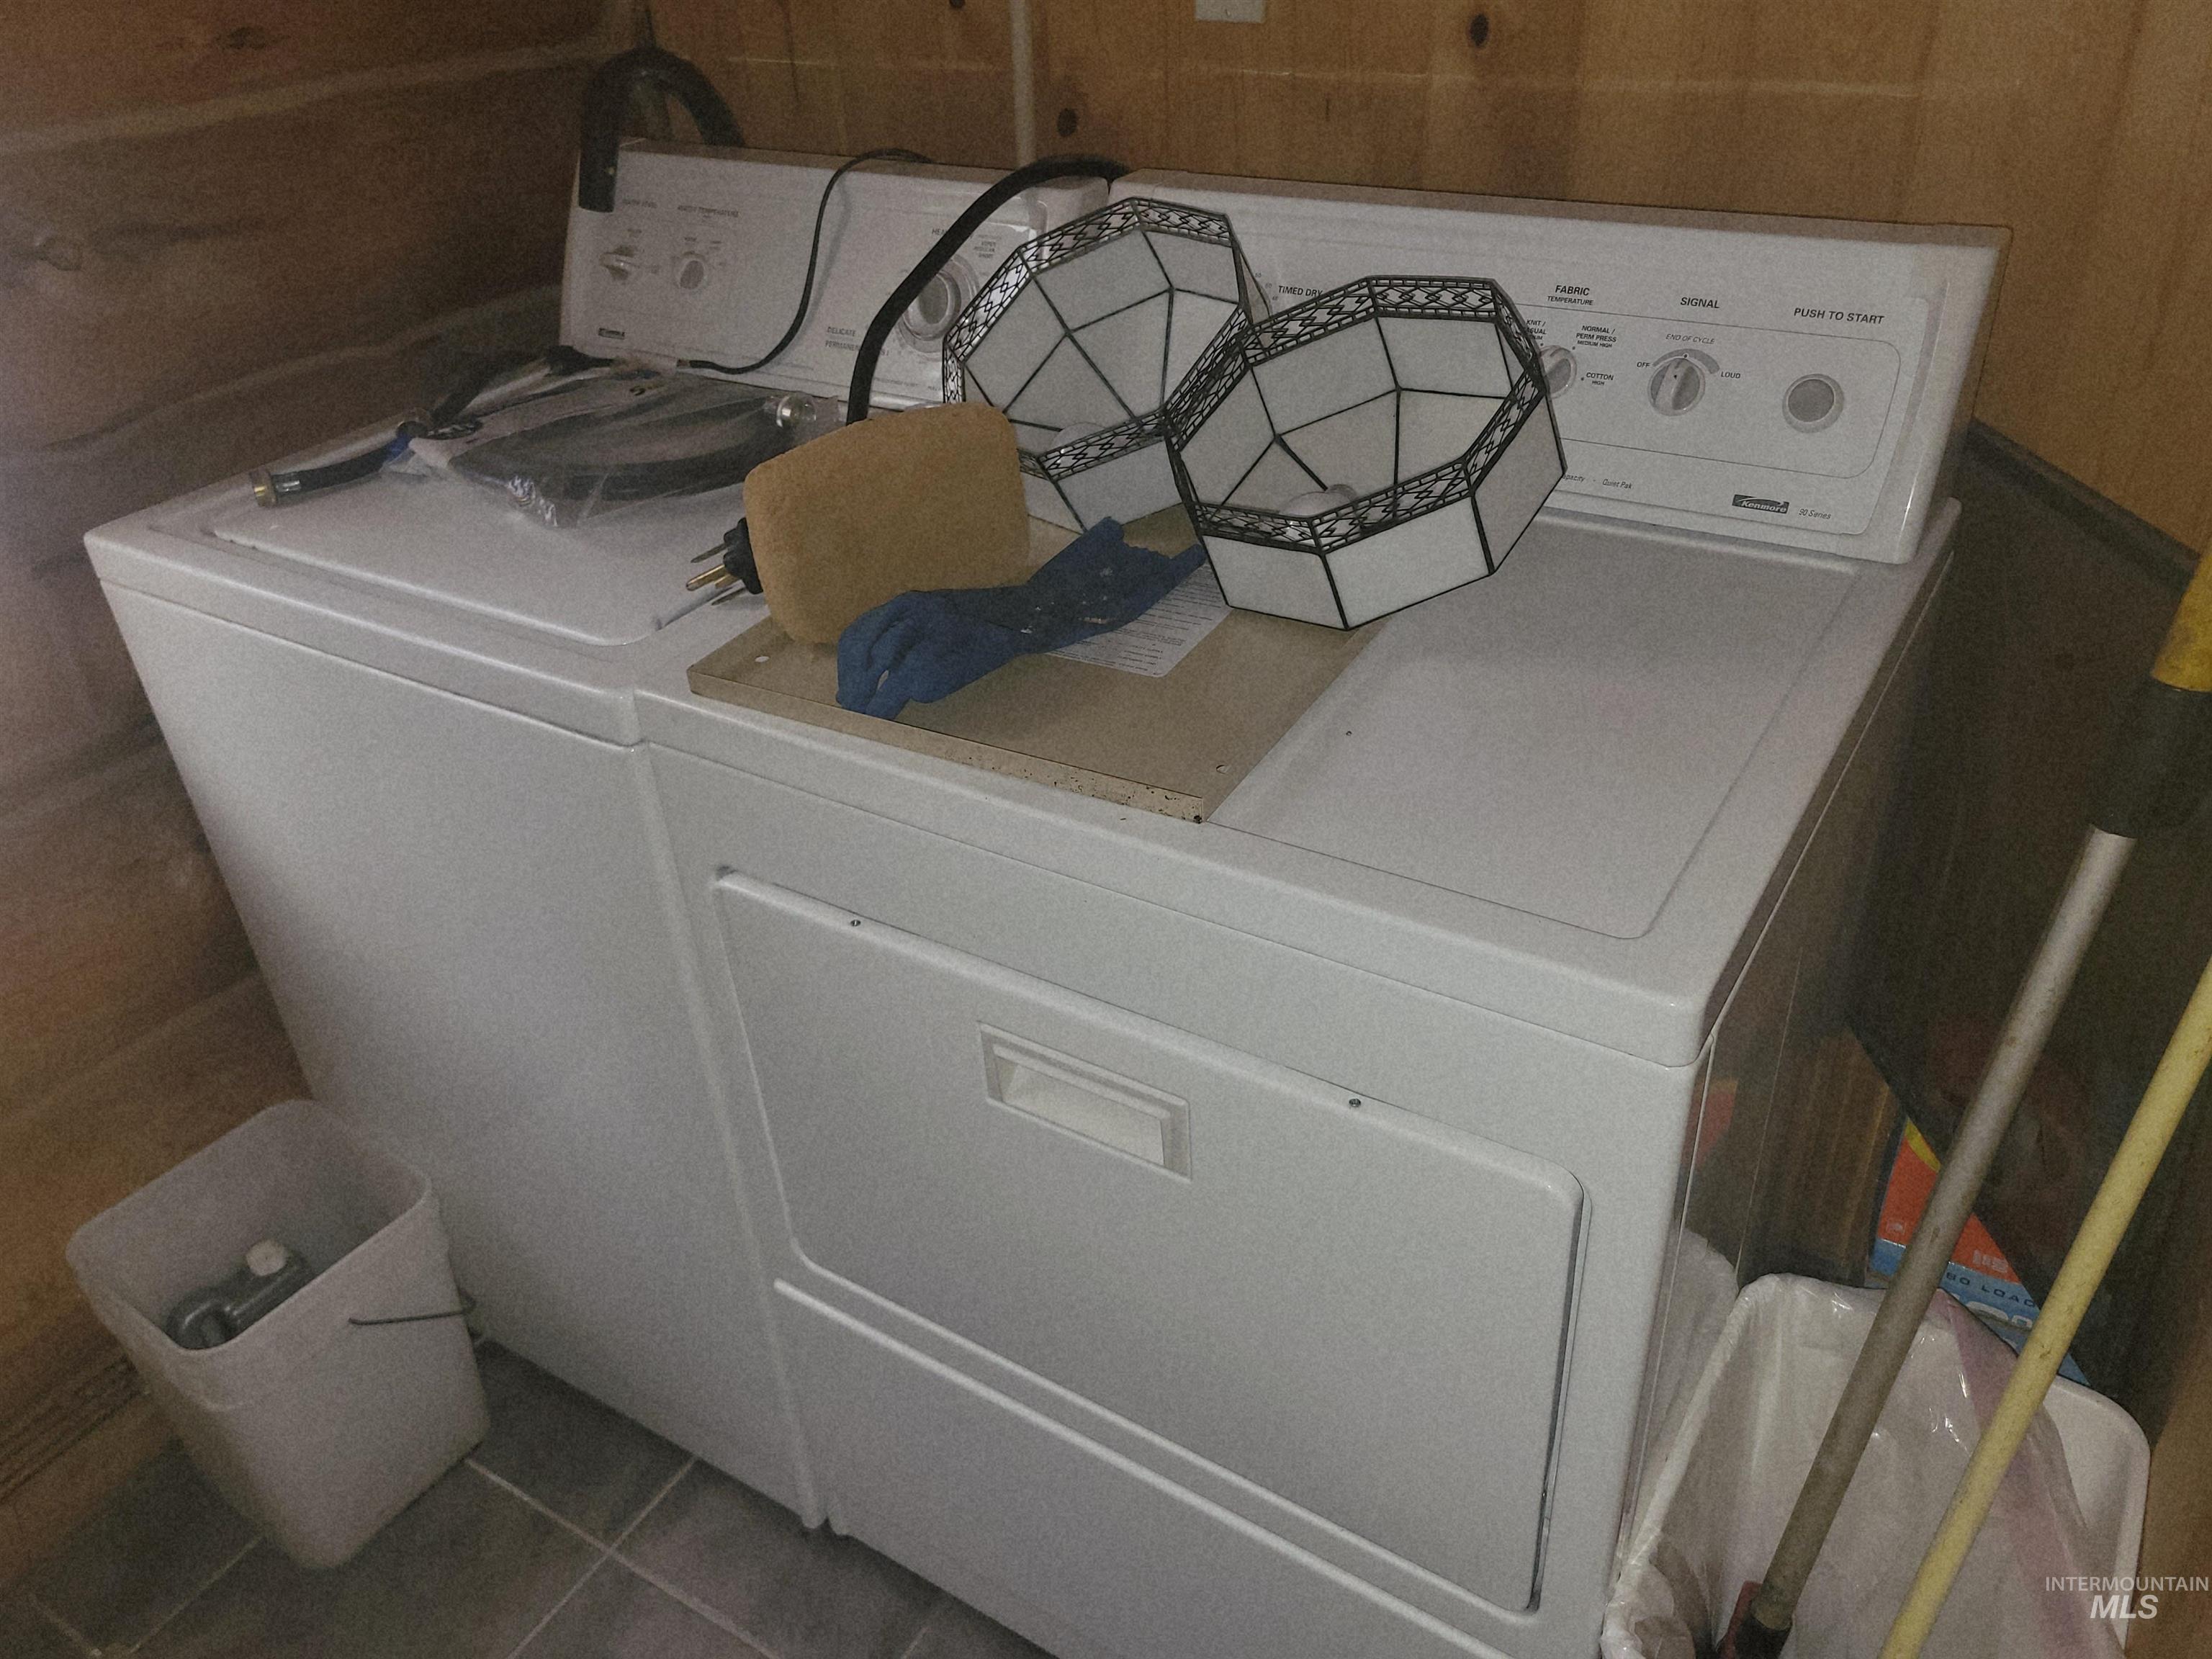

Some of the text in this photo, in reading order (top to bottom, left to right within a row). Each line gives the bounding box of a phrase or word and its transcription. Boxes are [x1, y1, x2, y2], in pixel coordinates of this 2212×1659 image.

[1278, 285, 1304, 295] TIMED
[1555, 285, 1591, 296] FABRIC
[1547, 296, 1594, 305] TEMPERATURE
[1680, 297, 1720, 309] SIGNAL
[1794, 307, 1885, 324] PUSH TO START
[1581, 325, 1610, 334] NORMAL
[1586, 372, 1614, 381] COTTON
[1741, 500, 1787, 513] Kenmore
